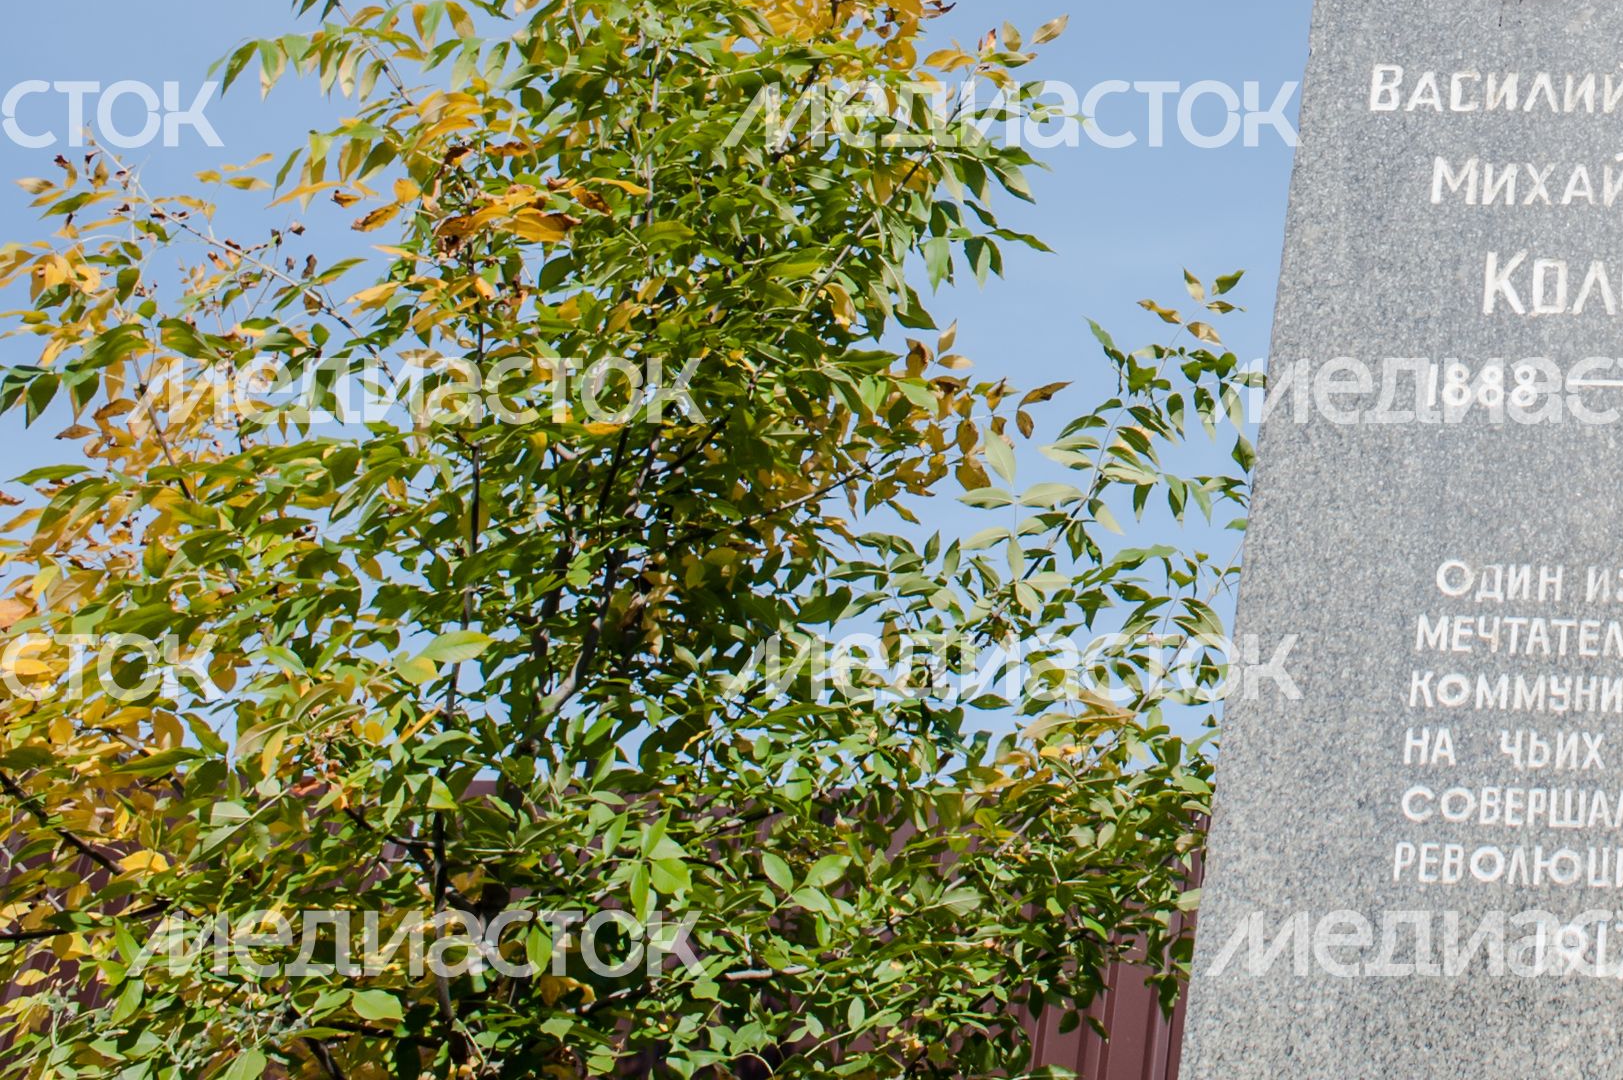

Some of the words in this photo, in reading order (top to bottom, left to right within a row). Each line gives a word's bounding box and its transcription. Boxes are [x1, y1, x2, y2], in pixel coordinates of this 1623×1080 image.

[1426, 363, 1539, 408] 1888
[1403, 727, 1456, 766] НА
[1501, 730, 1605, 770] ЧЬИХ
